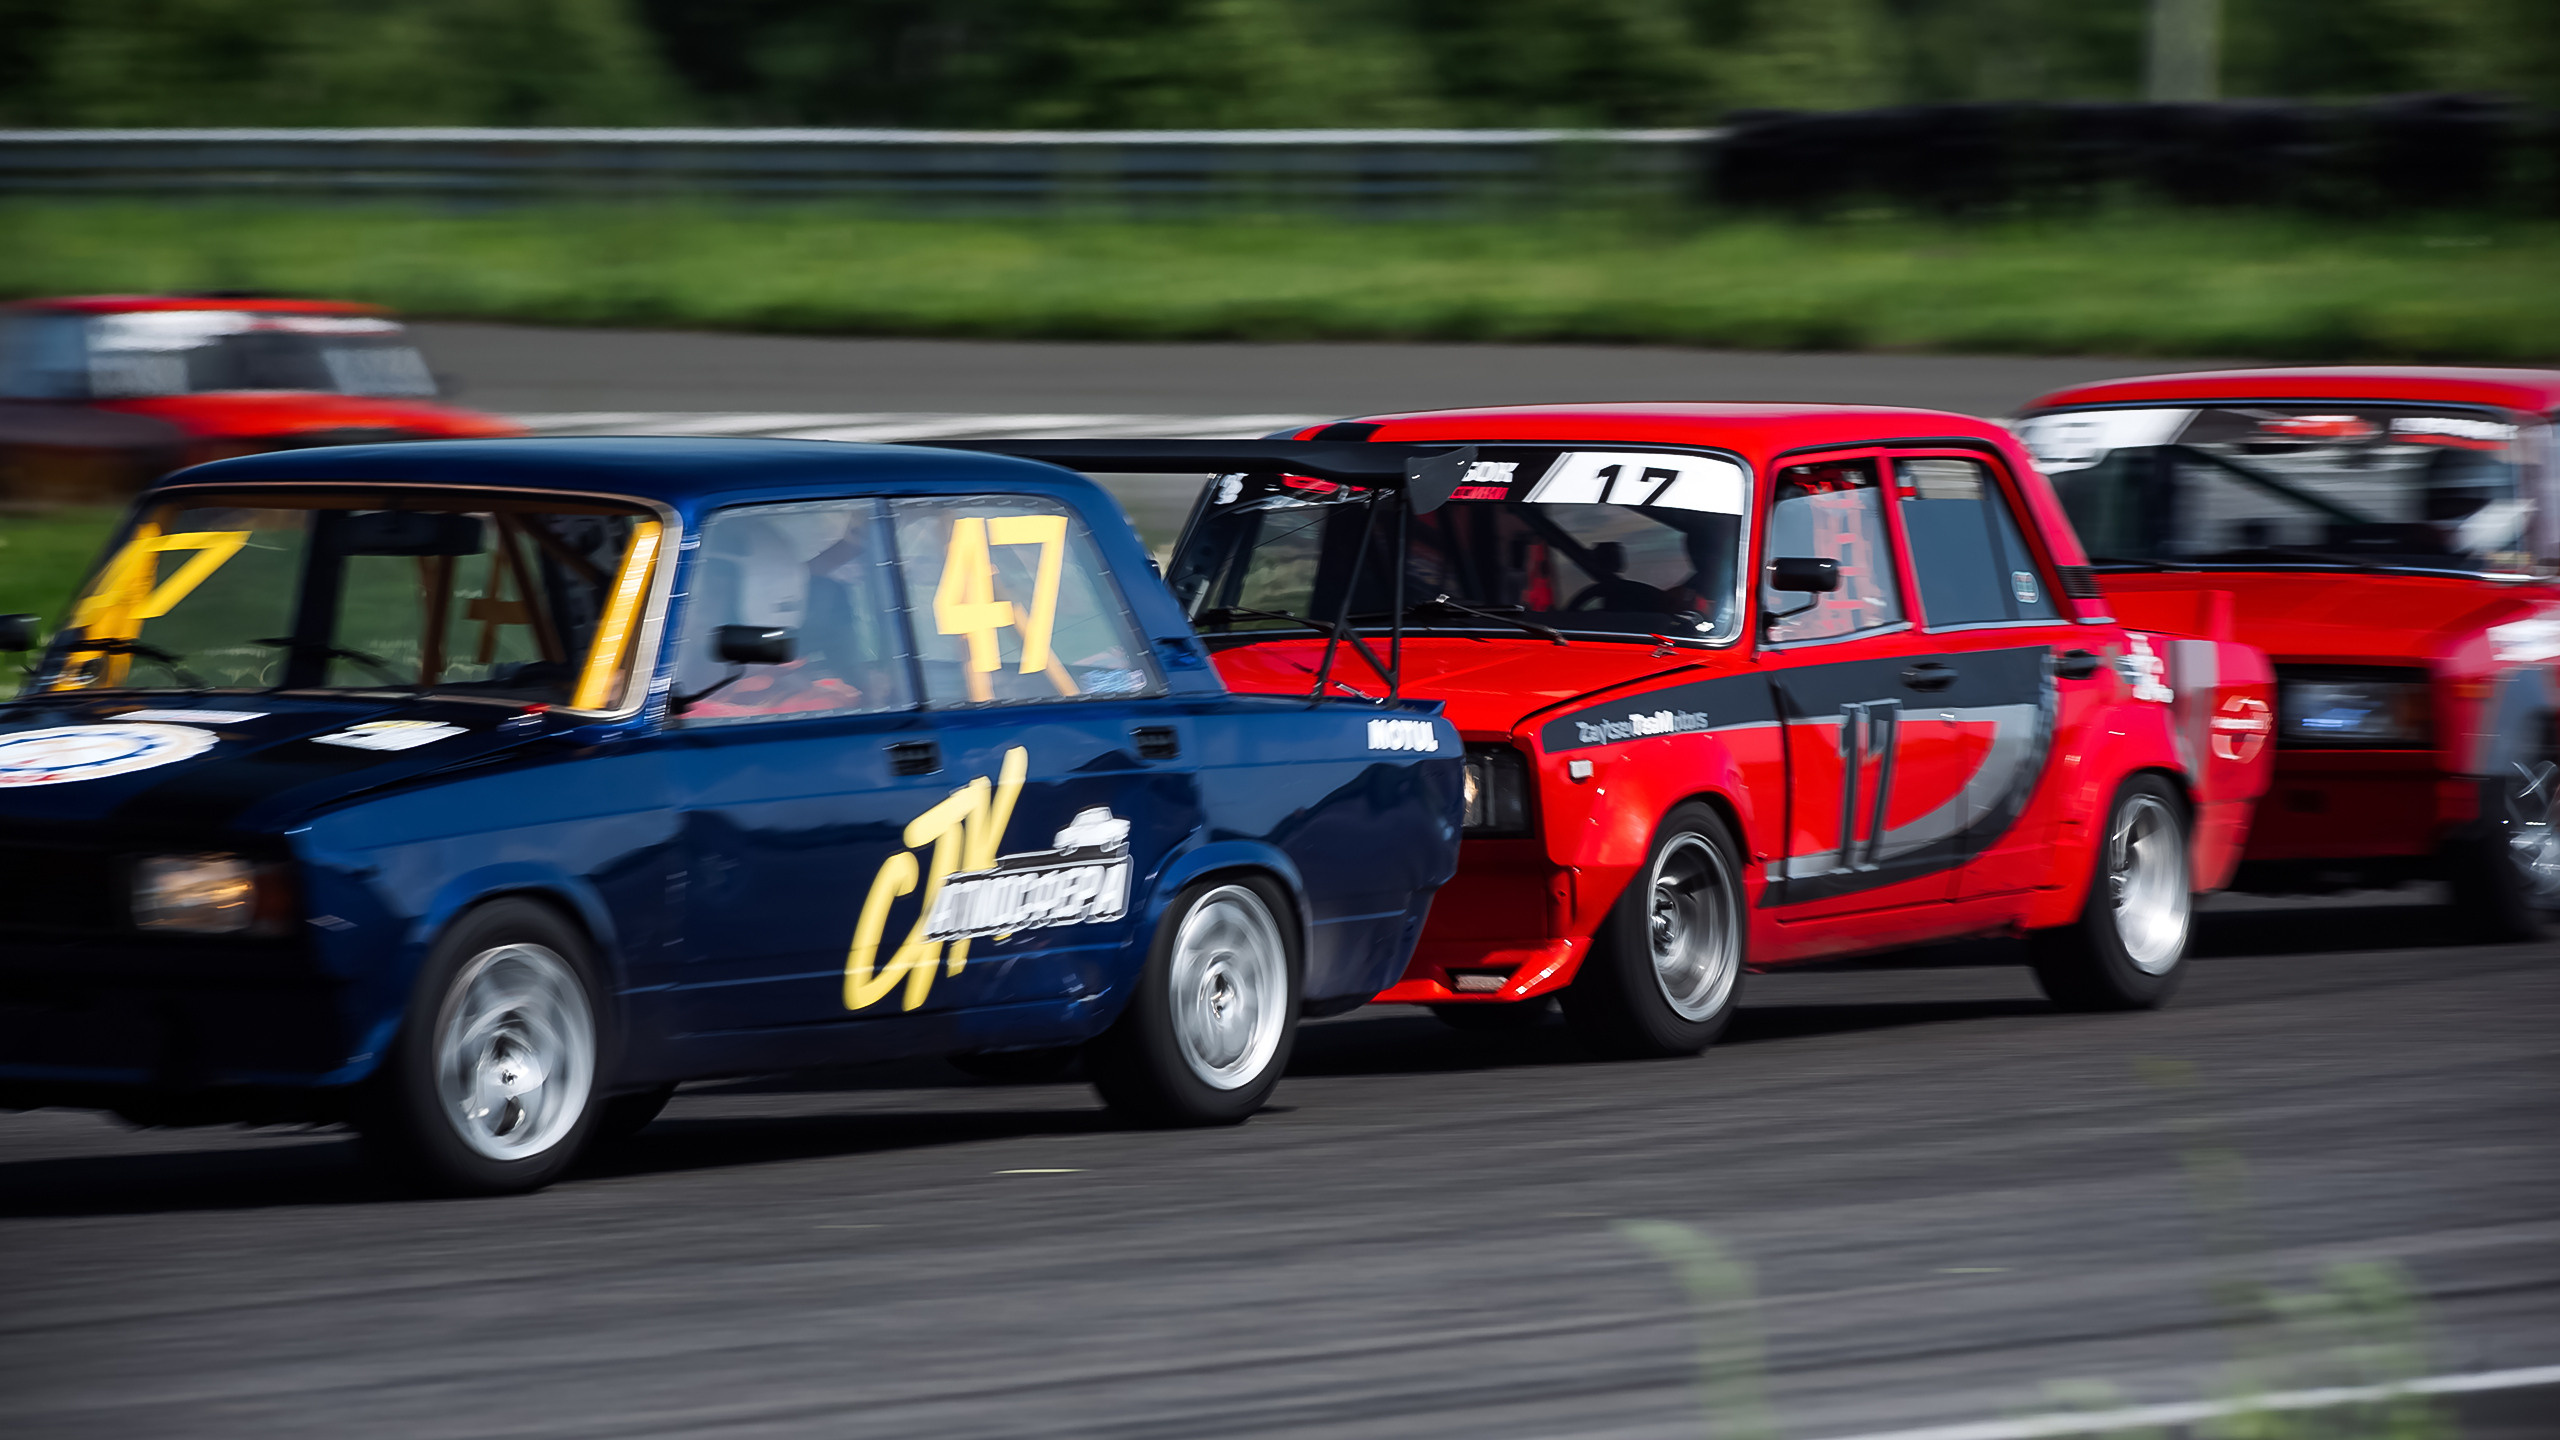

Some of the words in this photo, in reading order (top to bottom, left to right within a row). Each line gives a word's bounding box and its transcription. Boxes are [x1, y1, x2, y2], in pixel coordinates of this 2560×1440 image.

[1596, 464, 1680, 506] 17
[933, 515, 1068, 674] 47
[1367, 719, 1439, 752] MOTUL
[1832, 698, 1903, 873] 17
